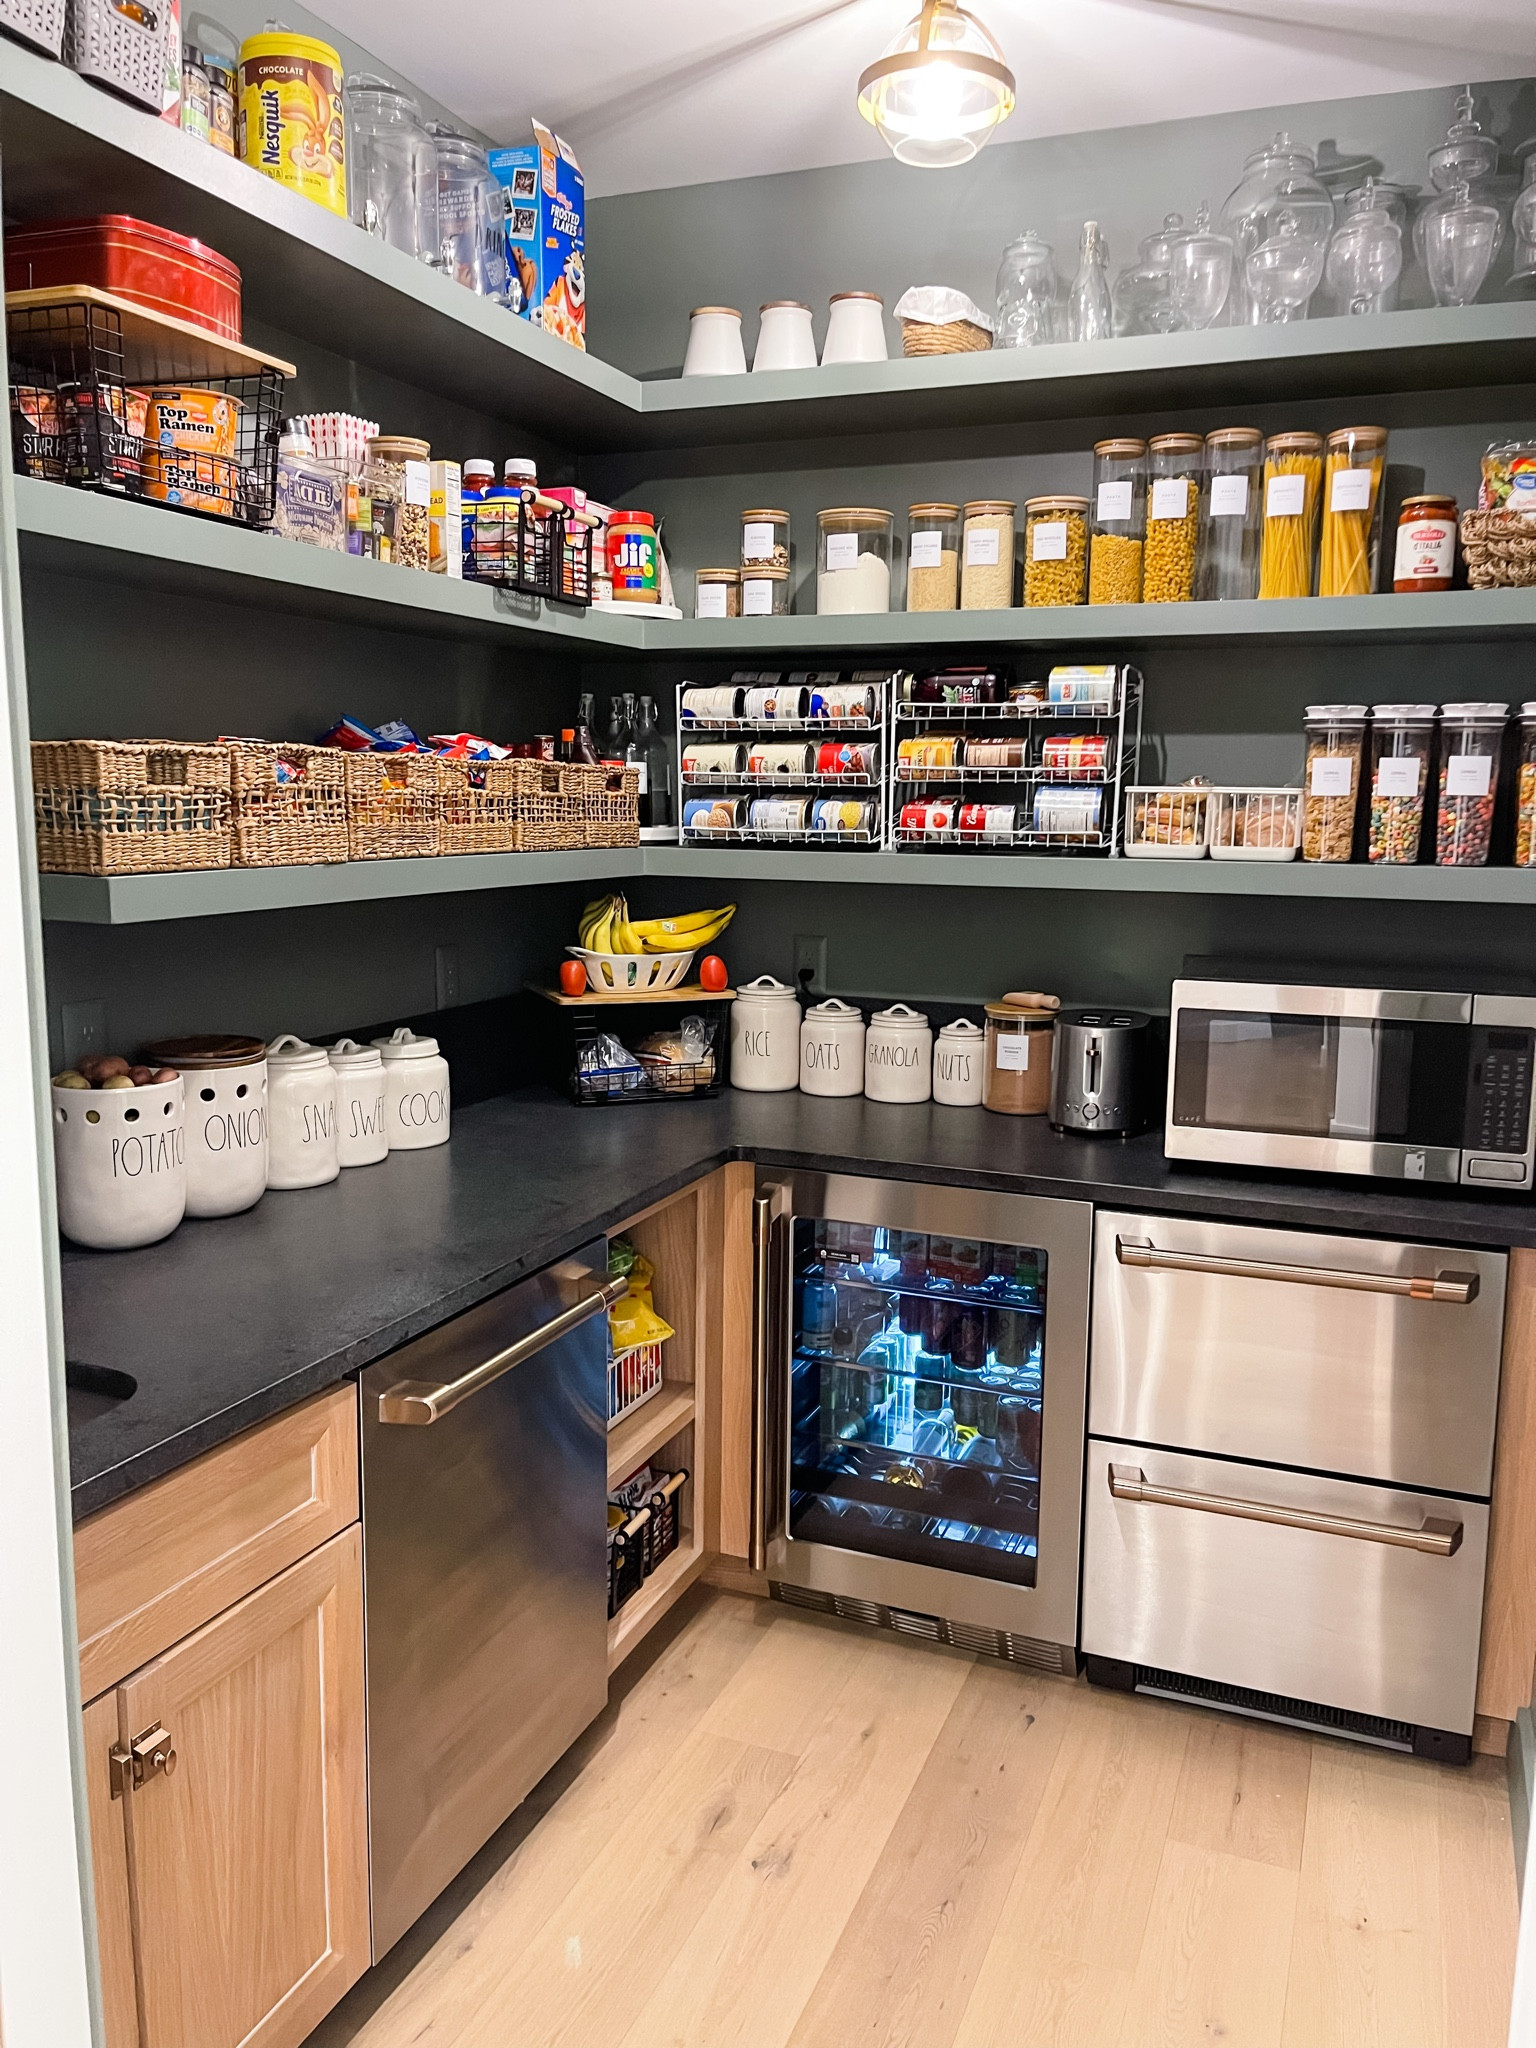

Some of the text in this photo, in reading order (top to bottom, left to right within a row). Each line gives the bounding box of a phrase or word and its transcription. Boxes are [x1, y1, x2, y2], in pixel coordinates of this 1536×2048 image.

[258, 65, 304, 76] CHOCOLATE
[261, 90, 286, 165] Nesquik
[550, 203, 580, 226] FROSTED
[552, 217, 578, 238] FLAKES
[157, 405, 188, 421] Top
[159, 417, 215, 434] Ramen
[429, 497, 444, 505] EAD
[613, 542, 652, 568] Jif
[745, 1030, 771, 1057] RICE
[868, 1043, 920, 1068] GRANOLA
[805, 1041, 840, 1071] OATS
[937, 1052, 971, 1082] NUTS
